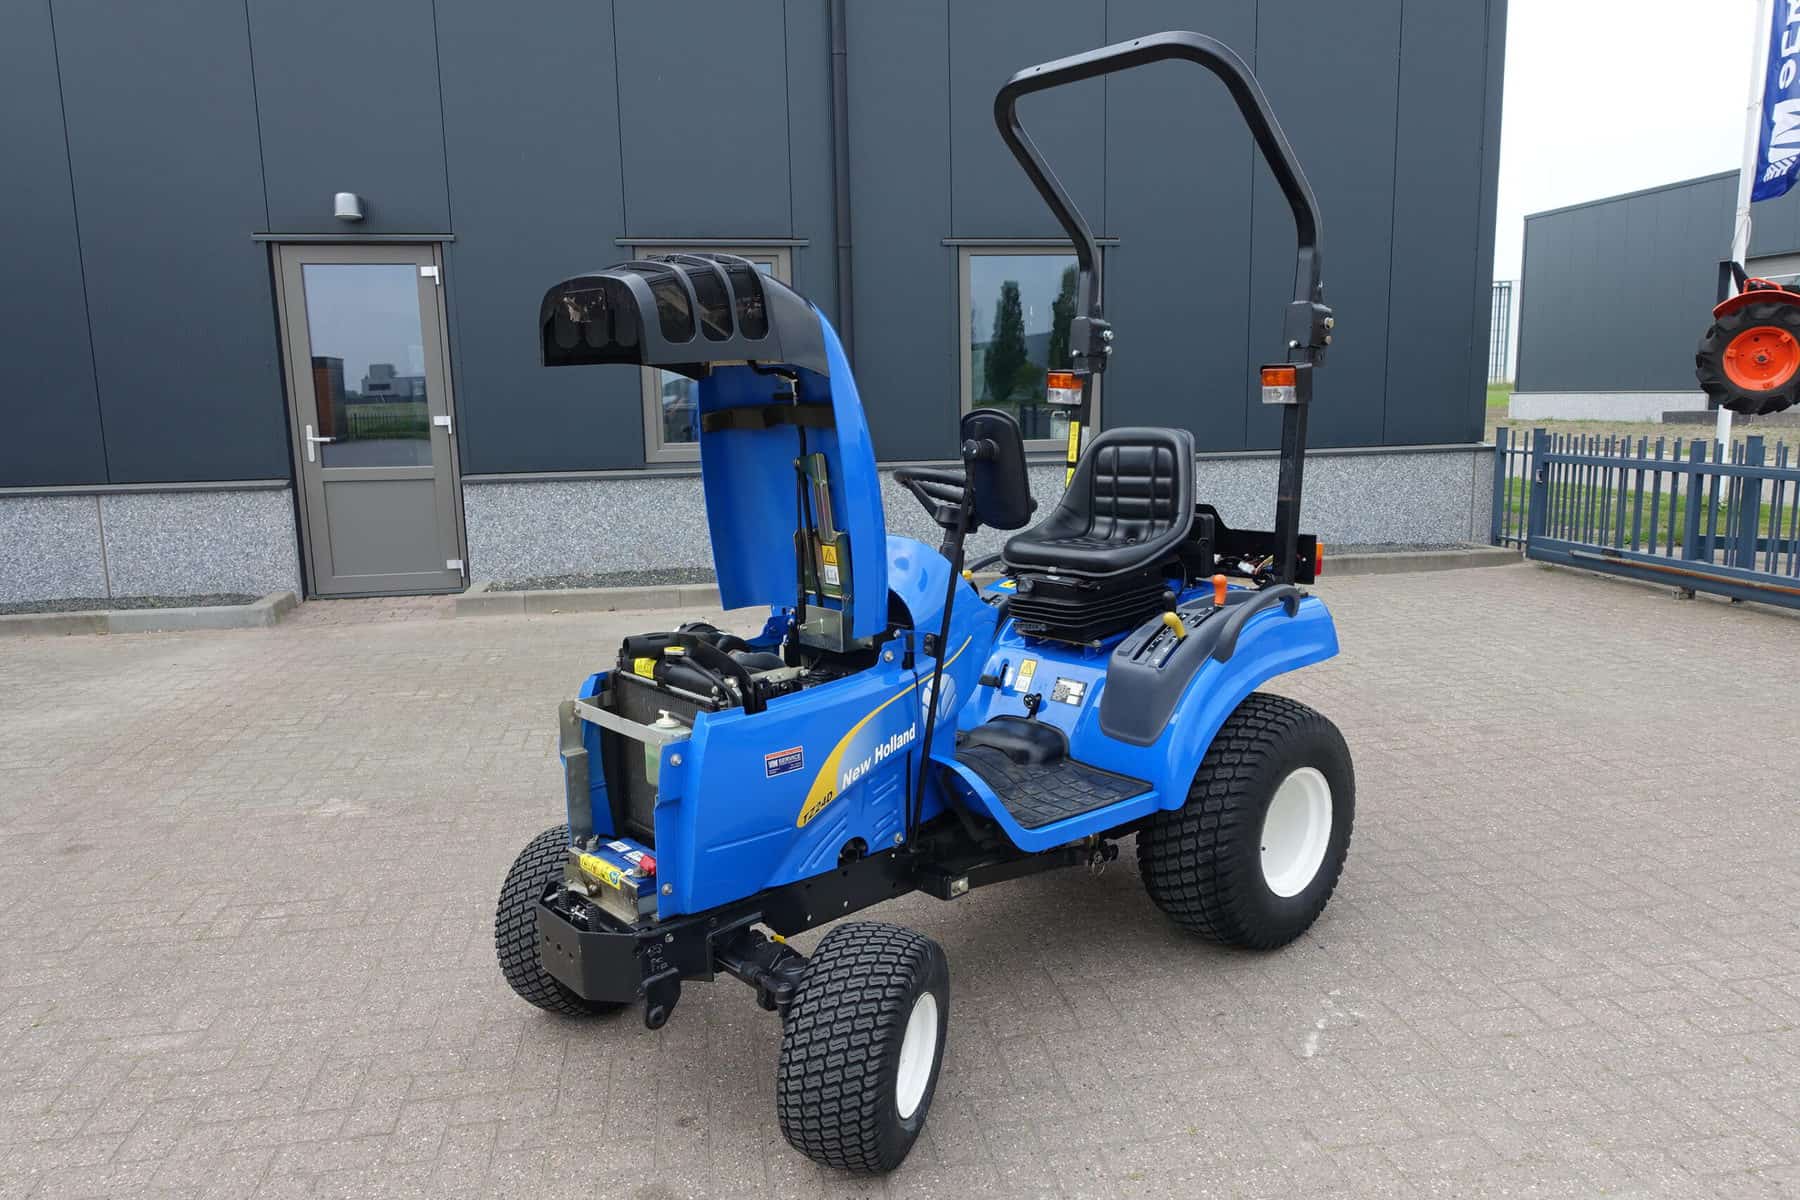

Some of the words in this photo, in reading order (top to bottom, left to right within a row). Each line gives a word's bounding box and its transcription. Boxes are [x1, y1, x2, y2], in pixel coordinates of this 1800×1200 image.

[841, 757, 872, 790] New
[874, 722, 916, 765] Holland
[803, 790, 834, 824] TZ24D
